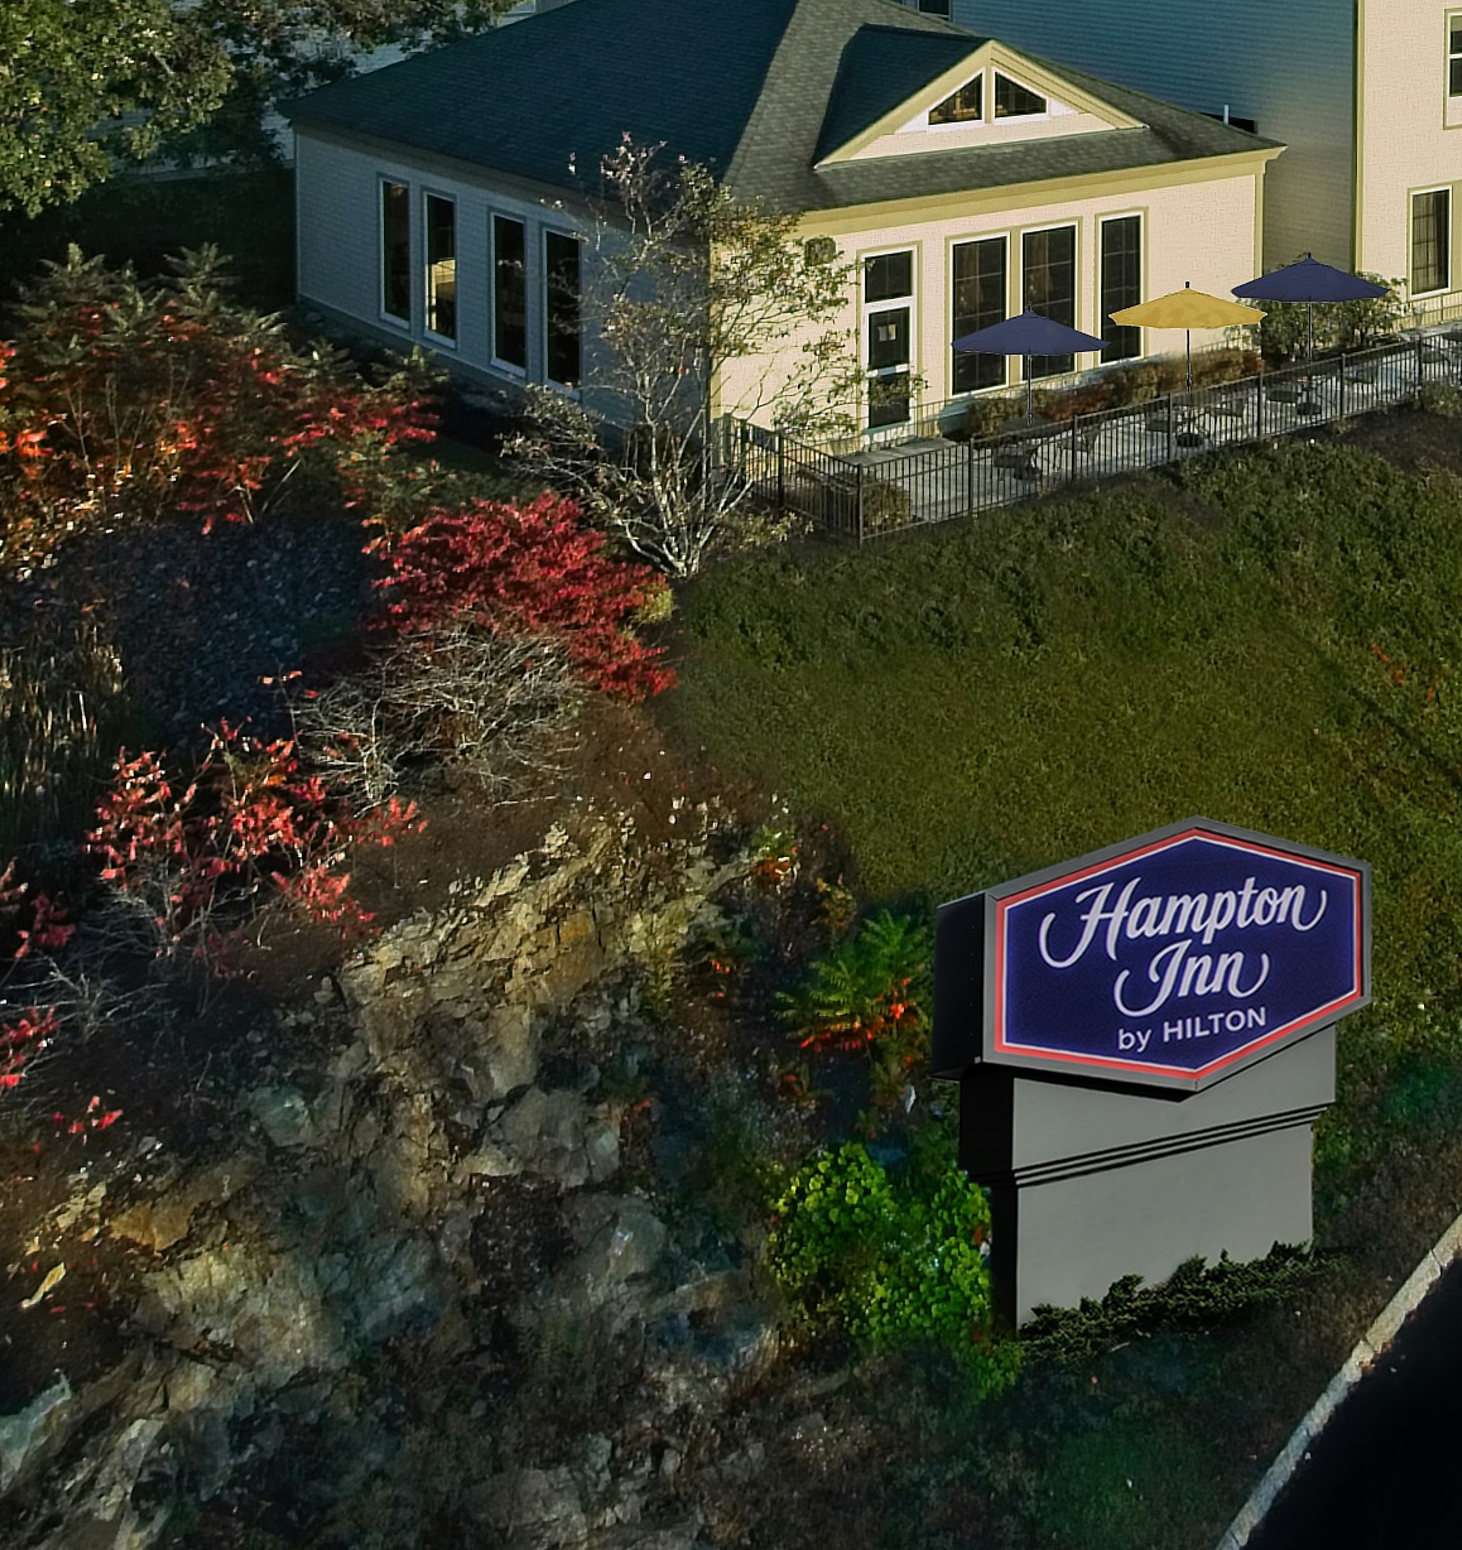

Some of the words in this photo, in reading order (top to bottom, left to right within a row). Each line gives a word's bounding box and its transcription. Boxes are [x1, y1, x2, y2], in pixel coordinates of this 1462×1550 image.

[1039, 877, 1327, 968] Hampton
[1113, 939, 1269, 1017] Inn
[1118, 1028, 1151, 1053] by
[1163, 1006, 1266, 1043] HILTON
